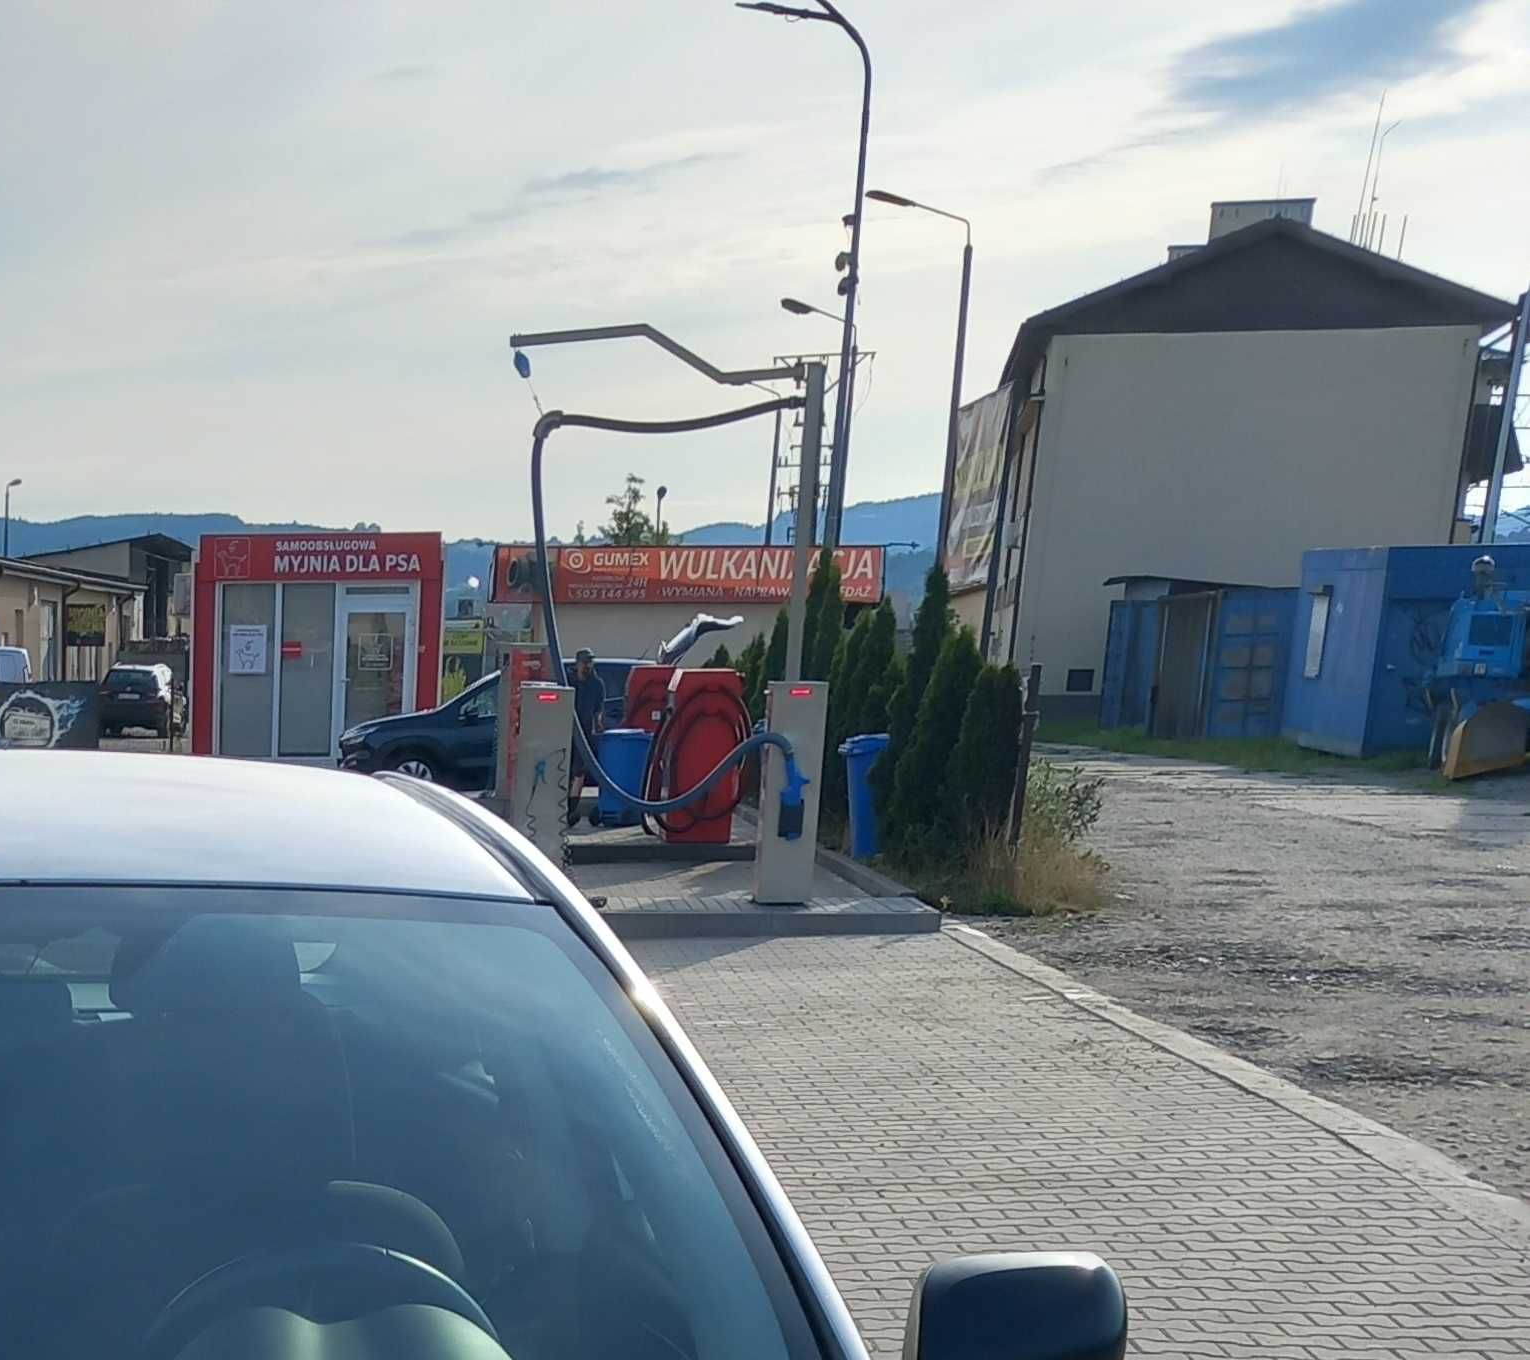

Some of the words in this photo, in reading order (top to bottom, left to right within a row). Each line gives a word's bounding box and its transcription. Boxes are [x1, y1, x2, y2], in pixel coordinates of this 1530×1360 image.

[276, 540, 376, 552] SAMOOBSŁUGOWA
[274, 555, 340, 574] MYJNIA
[346, 555, 380, 573] DLA
[385, 554, 420, 572] PSA
[593, 553, 649, 566] GUMEX
[660, 549, 874, 580] WULKANIAJA
[662, 586, 724, 598] WYMIANA
[734, 586, 792, 598] NAPRAW
